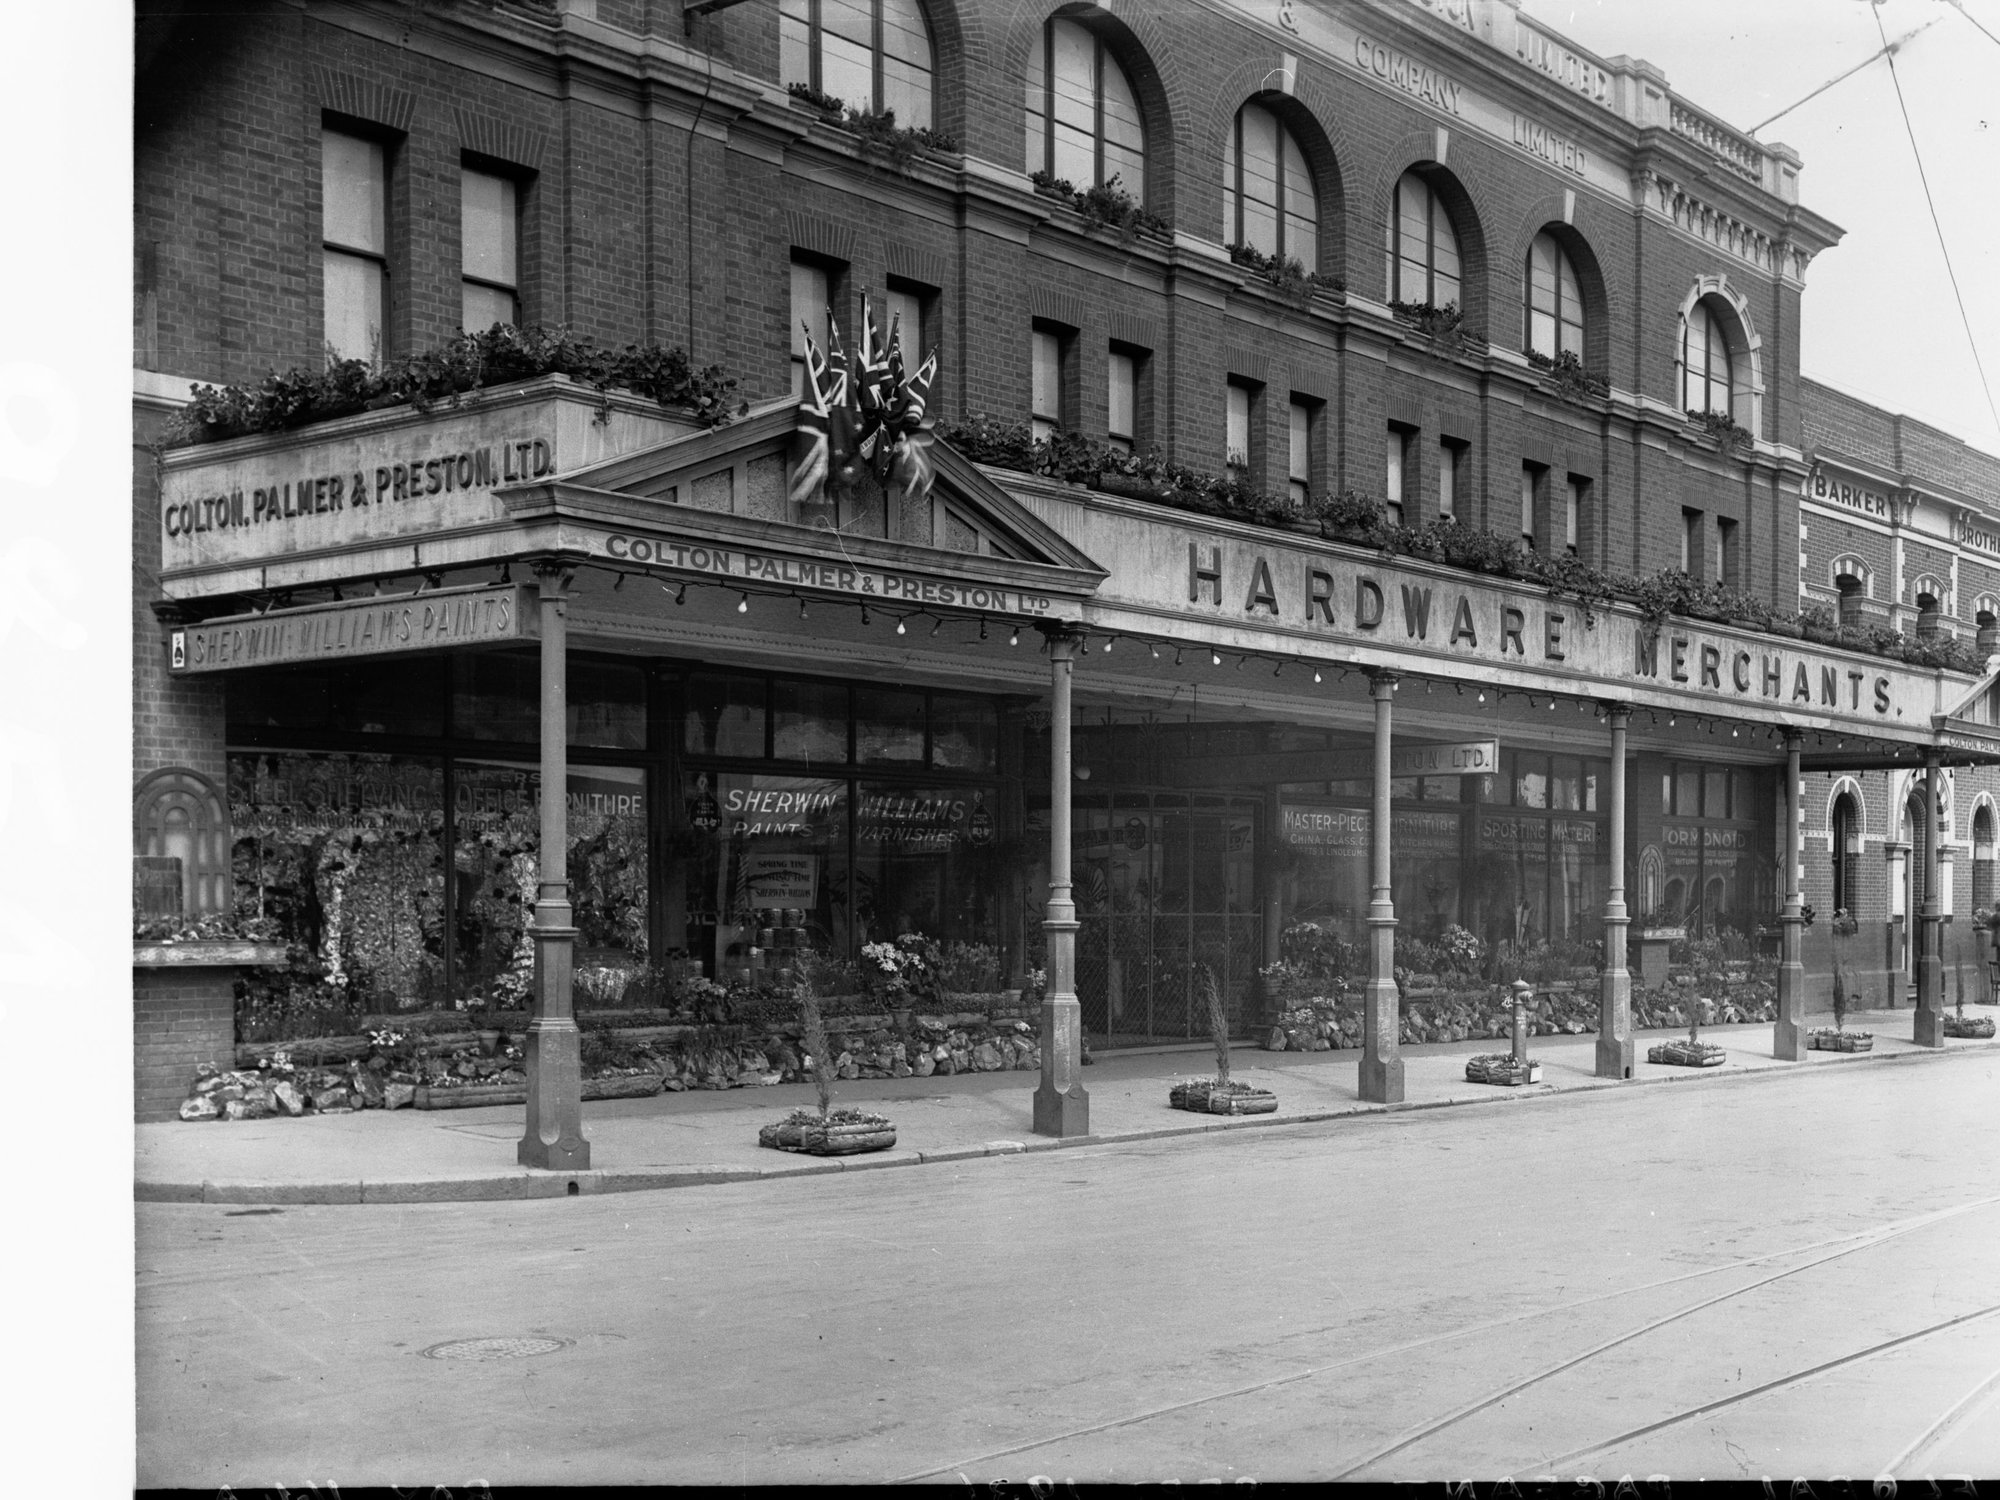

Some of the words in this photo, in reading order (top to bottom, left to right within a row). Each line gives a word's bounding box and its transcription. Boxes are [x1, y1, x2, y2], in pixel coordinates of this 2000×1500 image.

[1355, 34, 1462, 116] COMPANY
[1513, 114, 1587, 177] LIMITED
[253, 475, 344, 524] PALMER
[350, 471, 368, 507] &
[1815, 472, 1887, 518] BARKER
[745, 554, 856, 590] PALMER
[862, 575, 876, 594] &
[883, 575, 1007, 611] PRESTON
[304, 608, 413, 651] WILLIAMS
[423, 596, 512, 640] PAINTS
[1188, 542, 1565, 661] HARDWARE
[1634, 629, 1904, 717] MERCHANTS.
[1452, 749, 1488, 768] LTD.
[454, 784, 530, 814] OFFICE
[533, 788, 643, 817] FRNITURE
[855, 793, 964, 822] WILLIAMS
[732, 821, 814, 838] PAINTS
[1482, 819, 1545, 840] SPORTING
